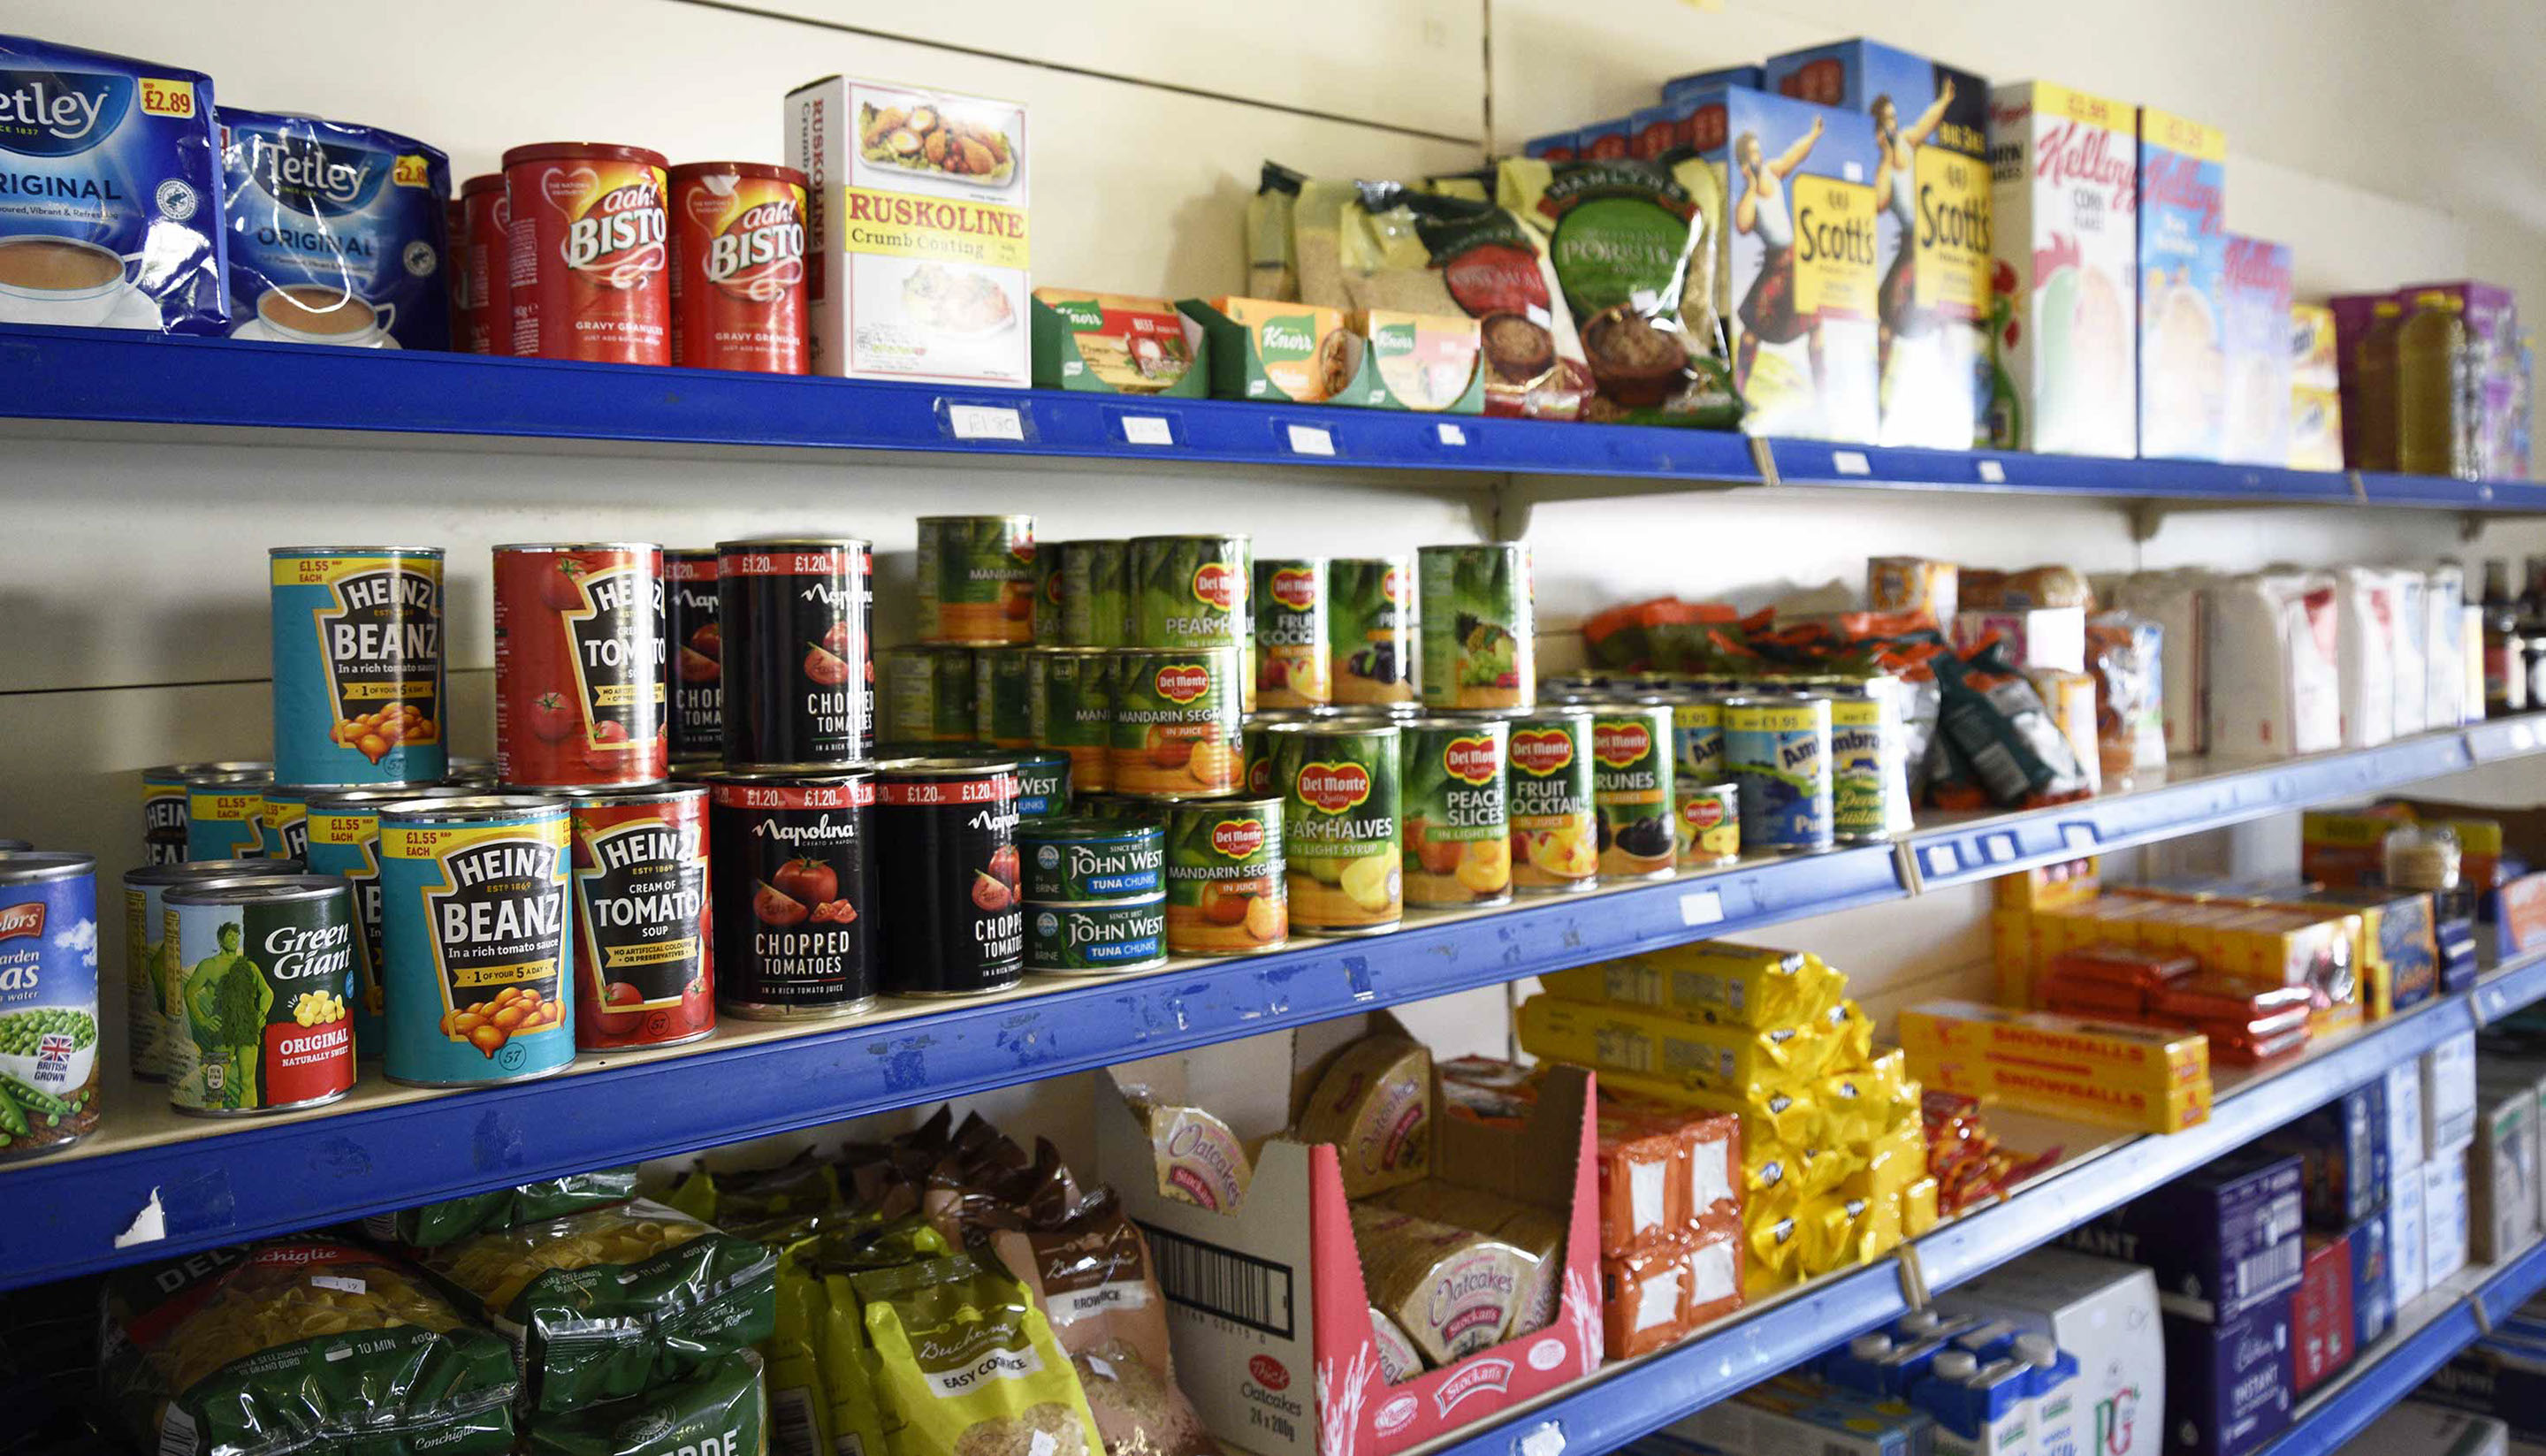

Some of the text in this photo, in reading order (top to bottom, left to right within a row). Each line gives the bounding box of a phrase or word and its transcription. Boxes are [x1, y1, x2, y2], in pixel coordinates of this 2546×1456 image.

[144, 90, 191, 113] £2.89
[0, 82, 108, 139] etley
[260, 141, 370, 202] Tetley
[812, 98, 826, 249] RUSKOLINE
[603, 181, 659, 213] aah!
[743, 197, 797, 230] aah!
[849, 193, 1025, 240] RUSKOLINE
[1919, 183, 1991, 255] Scott's
[568, 207, 667, 269] BISTO
[851, 227, 985, 260] Crumb Coating
[1799, 207, 1875, 266] Scott's
[710, 222, 804, 283] BISTO
[576, 321, 615, 332] GRAVY
[714, 332, 752, 342] GRAVY
[1262, 324, 1315, 352] Knorr
[299, 560, 329, 573] £1.55
[795, 555, 827, 572] £1.20
[299, 574, 323, 583] EACH
[346, 576, 431, 611] HEINZ
[1166, 617, 1213, 635] PEAR
[1277, 613, 1315, 629] FRUI
[333, 622, 438, 661] BEANZ
[1259, 629, 1315, 646] COCK
[338, 663, 349, 674] In
[360, 663, 381, 674] rich
[1159, 675, 1208, 688] Del Monte
[362, 685, 369, 697] 1
[1118, 709, 1183, 723] MANDARIN
[1165, 726, 1203, 736] IN JUICE
[1513, 742, 1570, 755] Del Monte
[1449, 752, 1469, 766] Del
[961, 783, 991, 801] £1.20
[1301, 776, 1367, 792] Del Monte
[1515, 780, 1567, 798] FRUIT
[217, 797, 247, 809] £1.55
[747, 789, 779, 806] £1.20
[804, 789, 836, 806] £1.20
[907, 786, 938, 803] £1.20
[1317, 793, 1350, 804] Quality
[217, 809, 240, 819] EACH
[1447, 808, 1504, 827] SLICES
[331, 819, 359, 831] £1.55
[752, 812, 855, 847] Napolina
[1325, 817, 1393, 839] HALVES
[332, 832, 354, 842] EACH
[406, 832, 438, 845] £1.55
[1216, 830, 1262, 843] Del Monte
[406, 847, 431, 857] EACH
[605, 832, 696, 870] HEINZ
[1109, 844, 1130, 853] SINCE
[1304, 843, 1377, 855] LIGHT SYRUP
[457, 848, 552, 886] HEINZ
[655, 865, 674, 873] 1869
[1069, 849, 1163, 880] JOHN WEST
[1169, 866, 1240, 880] MANDARIN
[629, 880, 676, 895] CREAM OF
[1035, 884, 1060, 894] BRINE
[1092, 873, 1156, 890] TUNA CHUNKS
[594, 890, 701, 927] TOMATO
[443, 892, 561, 944] BEANZ
[264, 922, 349, 955] Green
[642, 925, 669, 938] SOUP
[1068, 915, 1164, 948] JOHN WEST
[448, 948, 461, 958] In
[472, 945, 495, 957] rich
[497, 942, 535, 955] tomato
[536, 938, 559, 949] sauce
[626, 946, 664, 956] ARTIFICIAL
[755, 930, 850, 956] CHOPPED
[1091, 941, 1156, 957] TUNA CHUNKS
[0, 949, 40, 964] arden
[273, 943, 353, 980] Giant
[636, 949, 685, 963] PRESERVATIVES
[1034, 951, 1059, 961] BRINE
[474, 966, 544, 982] 1 OF YOUR 5 DAY
[764, 956, 842, 976] TOMATOES
[1, 964, 40, 992] as
[7, 991, 40, 1002] water
[779, 986, 796, 995] RICH
[797, 985, 824, 995] TOMATO
[826, 984, 844, 994] JUICE
[279, 1027, 348, 1056] ORIGINAL
[282, 1045, 348, 1067] NATURALLY SWEET
[503, 1048, 522, 1064] 57
[36, 1061, 67, 1072] BRITISH
[34, 1071, 65, 1083] GROWN
[256, 1247, 339, 1266] chiglie
[1429, 1267, 1514, 1328] Oatcakes
[357, 1338, 397, 1354] 10 MIN
[942, 1369, 977, 1390] EASY
[1446, 1366, 1502, 1401] Stockan's
[1239, 1381, 1302, 1417] Oatcakes
[1271, 1414, 1296, 1443] 200g
